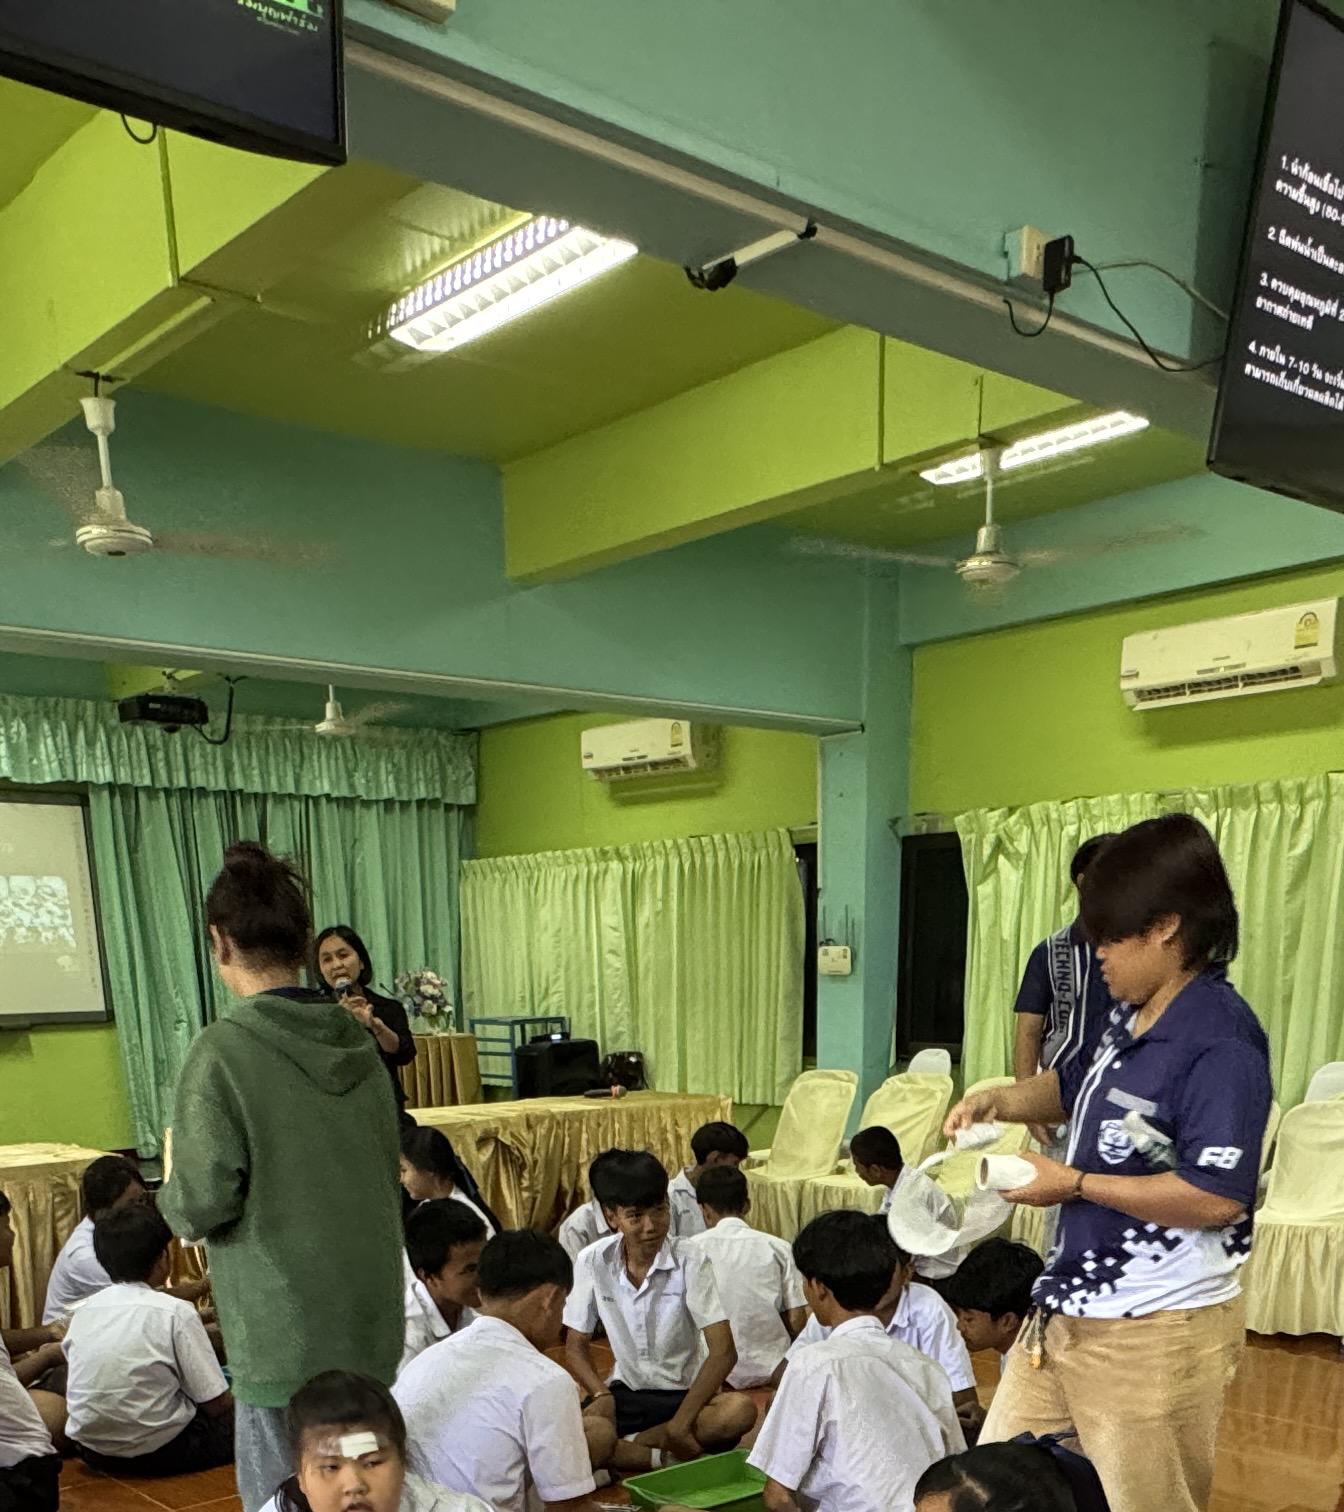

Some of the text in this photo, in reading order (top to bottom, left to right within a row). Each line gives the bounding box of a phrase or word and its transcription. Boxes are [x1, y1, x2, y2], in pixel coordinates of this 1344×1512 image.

[1259, 344, 1286, 366] ภายใน
[1288, 356, 1310, 376] 7-10
[1311, 362, 1323, 380] วัน
[1197, 1146, 1244, 1170] 68
